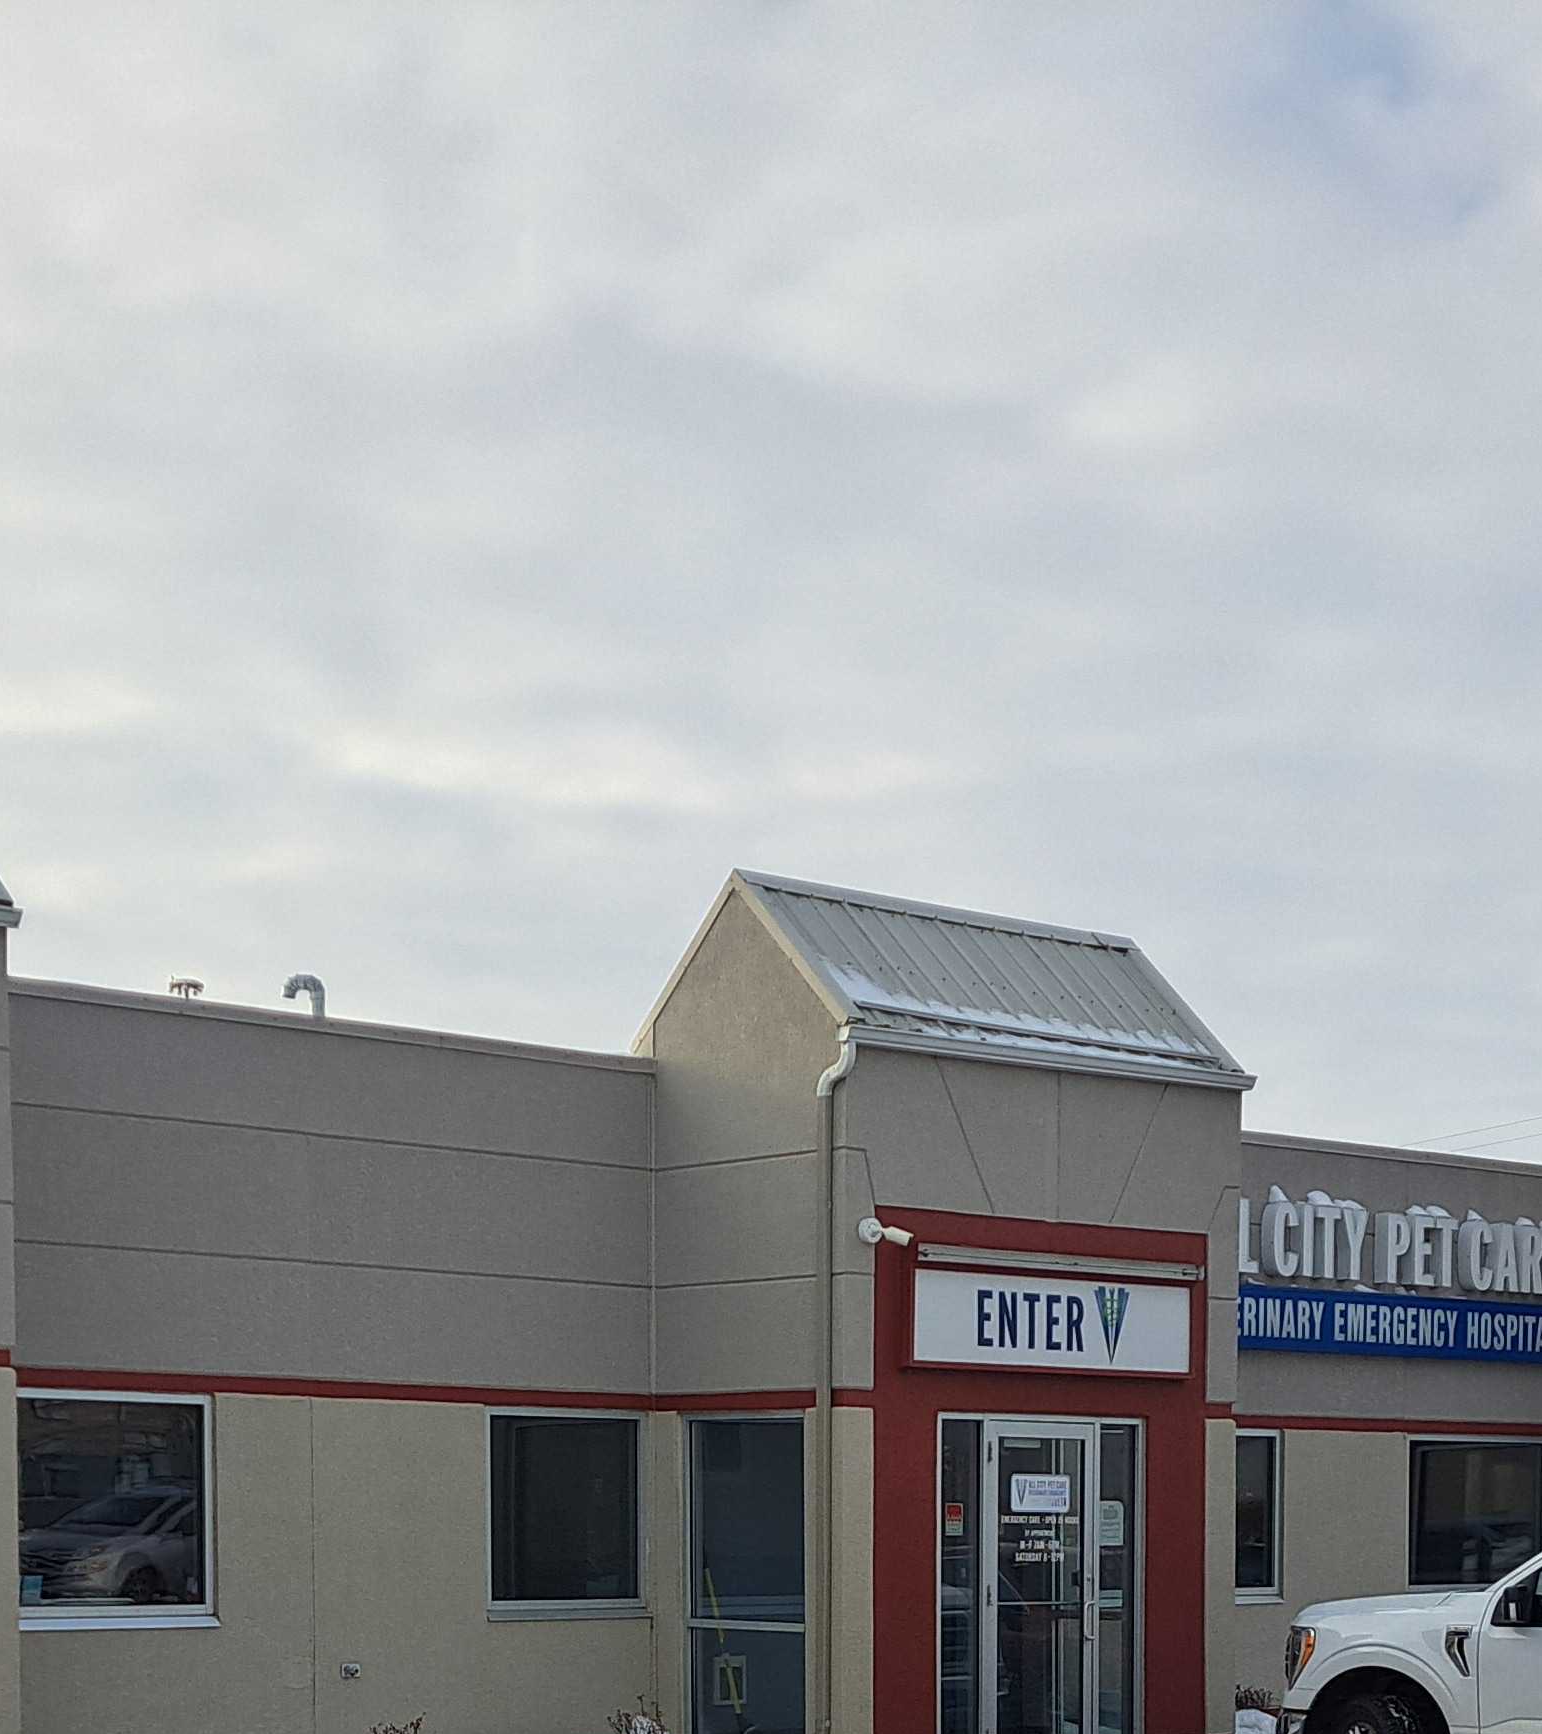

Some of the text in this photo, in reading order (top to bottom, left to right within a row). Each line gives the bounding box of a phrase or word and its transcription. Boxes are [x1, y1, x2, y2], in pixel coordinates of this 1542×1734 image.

[1262, 1201, 1369, 1281] CITY
[1374, 1212, 1458, 1288] PET
[977, 1289, 1084, 1352] ENTER
[1237, 1296, 1325, 1340] RINARY
[1333, 1302, 1458, 1348] EMERGENCY
